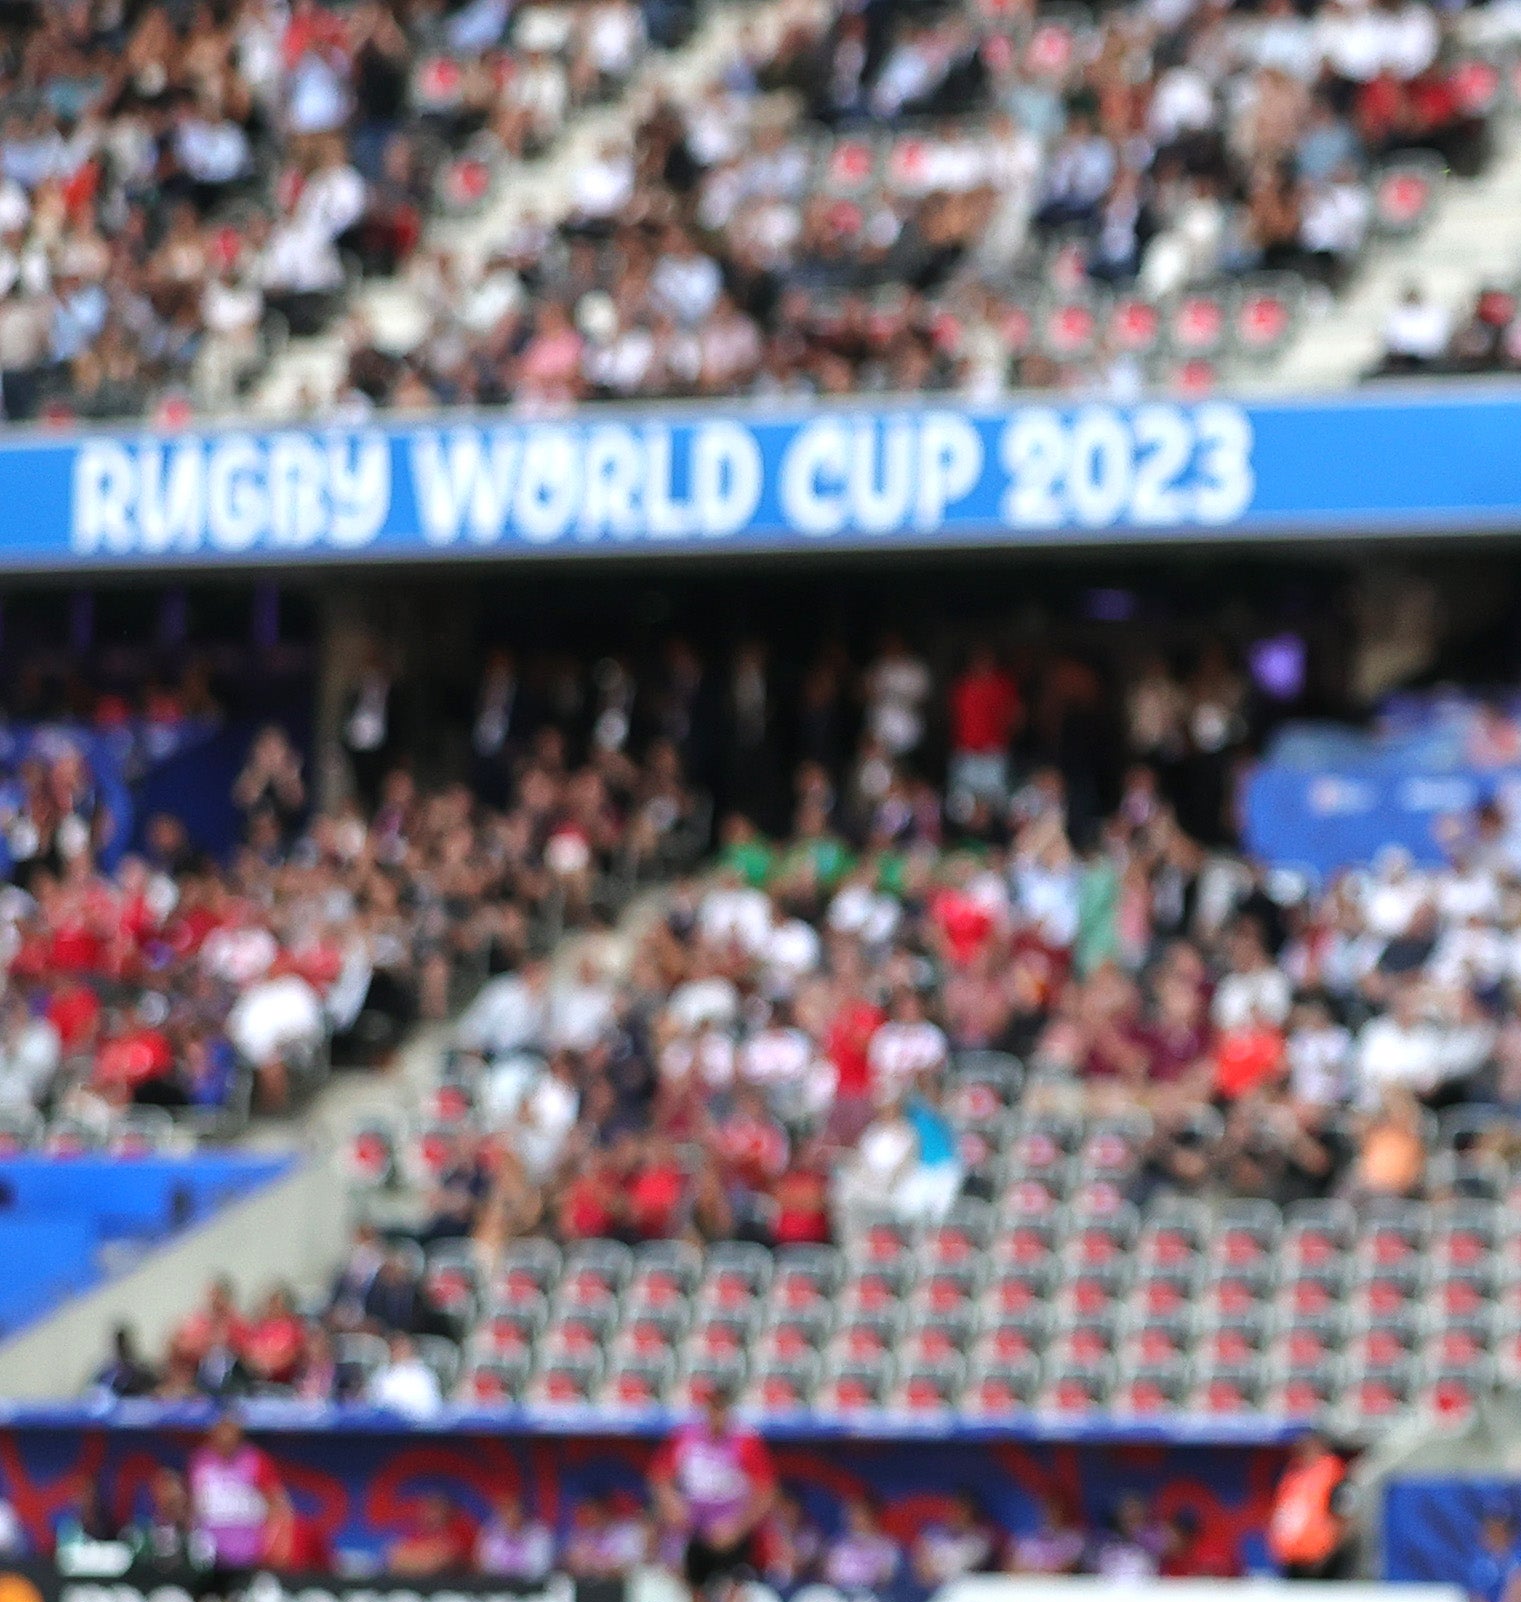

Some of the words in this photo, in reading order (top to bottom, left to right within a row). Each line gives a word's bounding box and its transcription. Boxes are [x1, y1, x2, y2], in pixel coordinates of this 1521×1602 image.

[72, 430, 391, 556] RUGBY
[410, 418, 764, 547] WORLD
[778, 411, 983, 536] CUP
[1002, 403, 1256, 530] 2023
